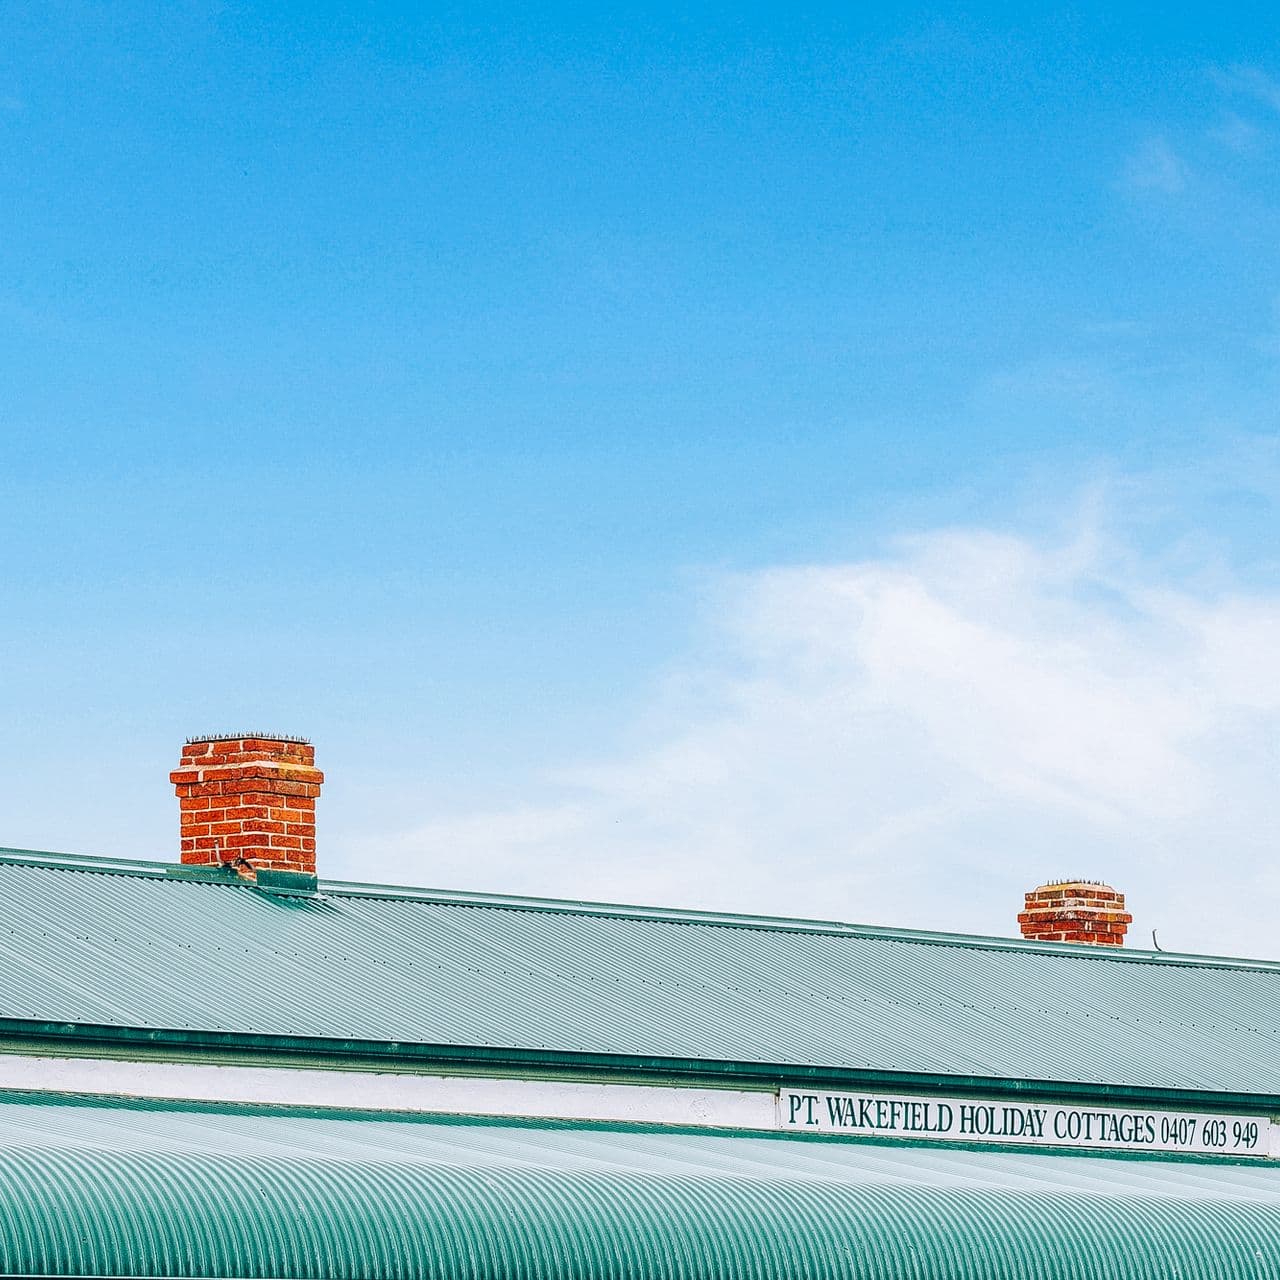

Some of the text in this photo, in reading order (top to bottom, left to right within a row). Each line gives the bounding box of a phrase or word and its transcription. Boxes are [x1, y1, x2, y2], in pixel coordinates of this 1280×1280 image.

[788, 1094, 1258, 1149] PT. WAKEFIELD HOLIDAY COTTAGES 0407 603 949
